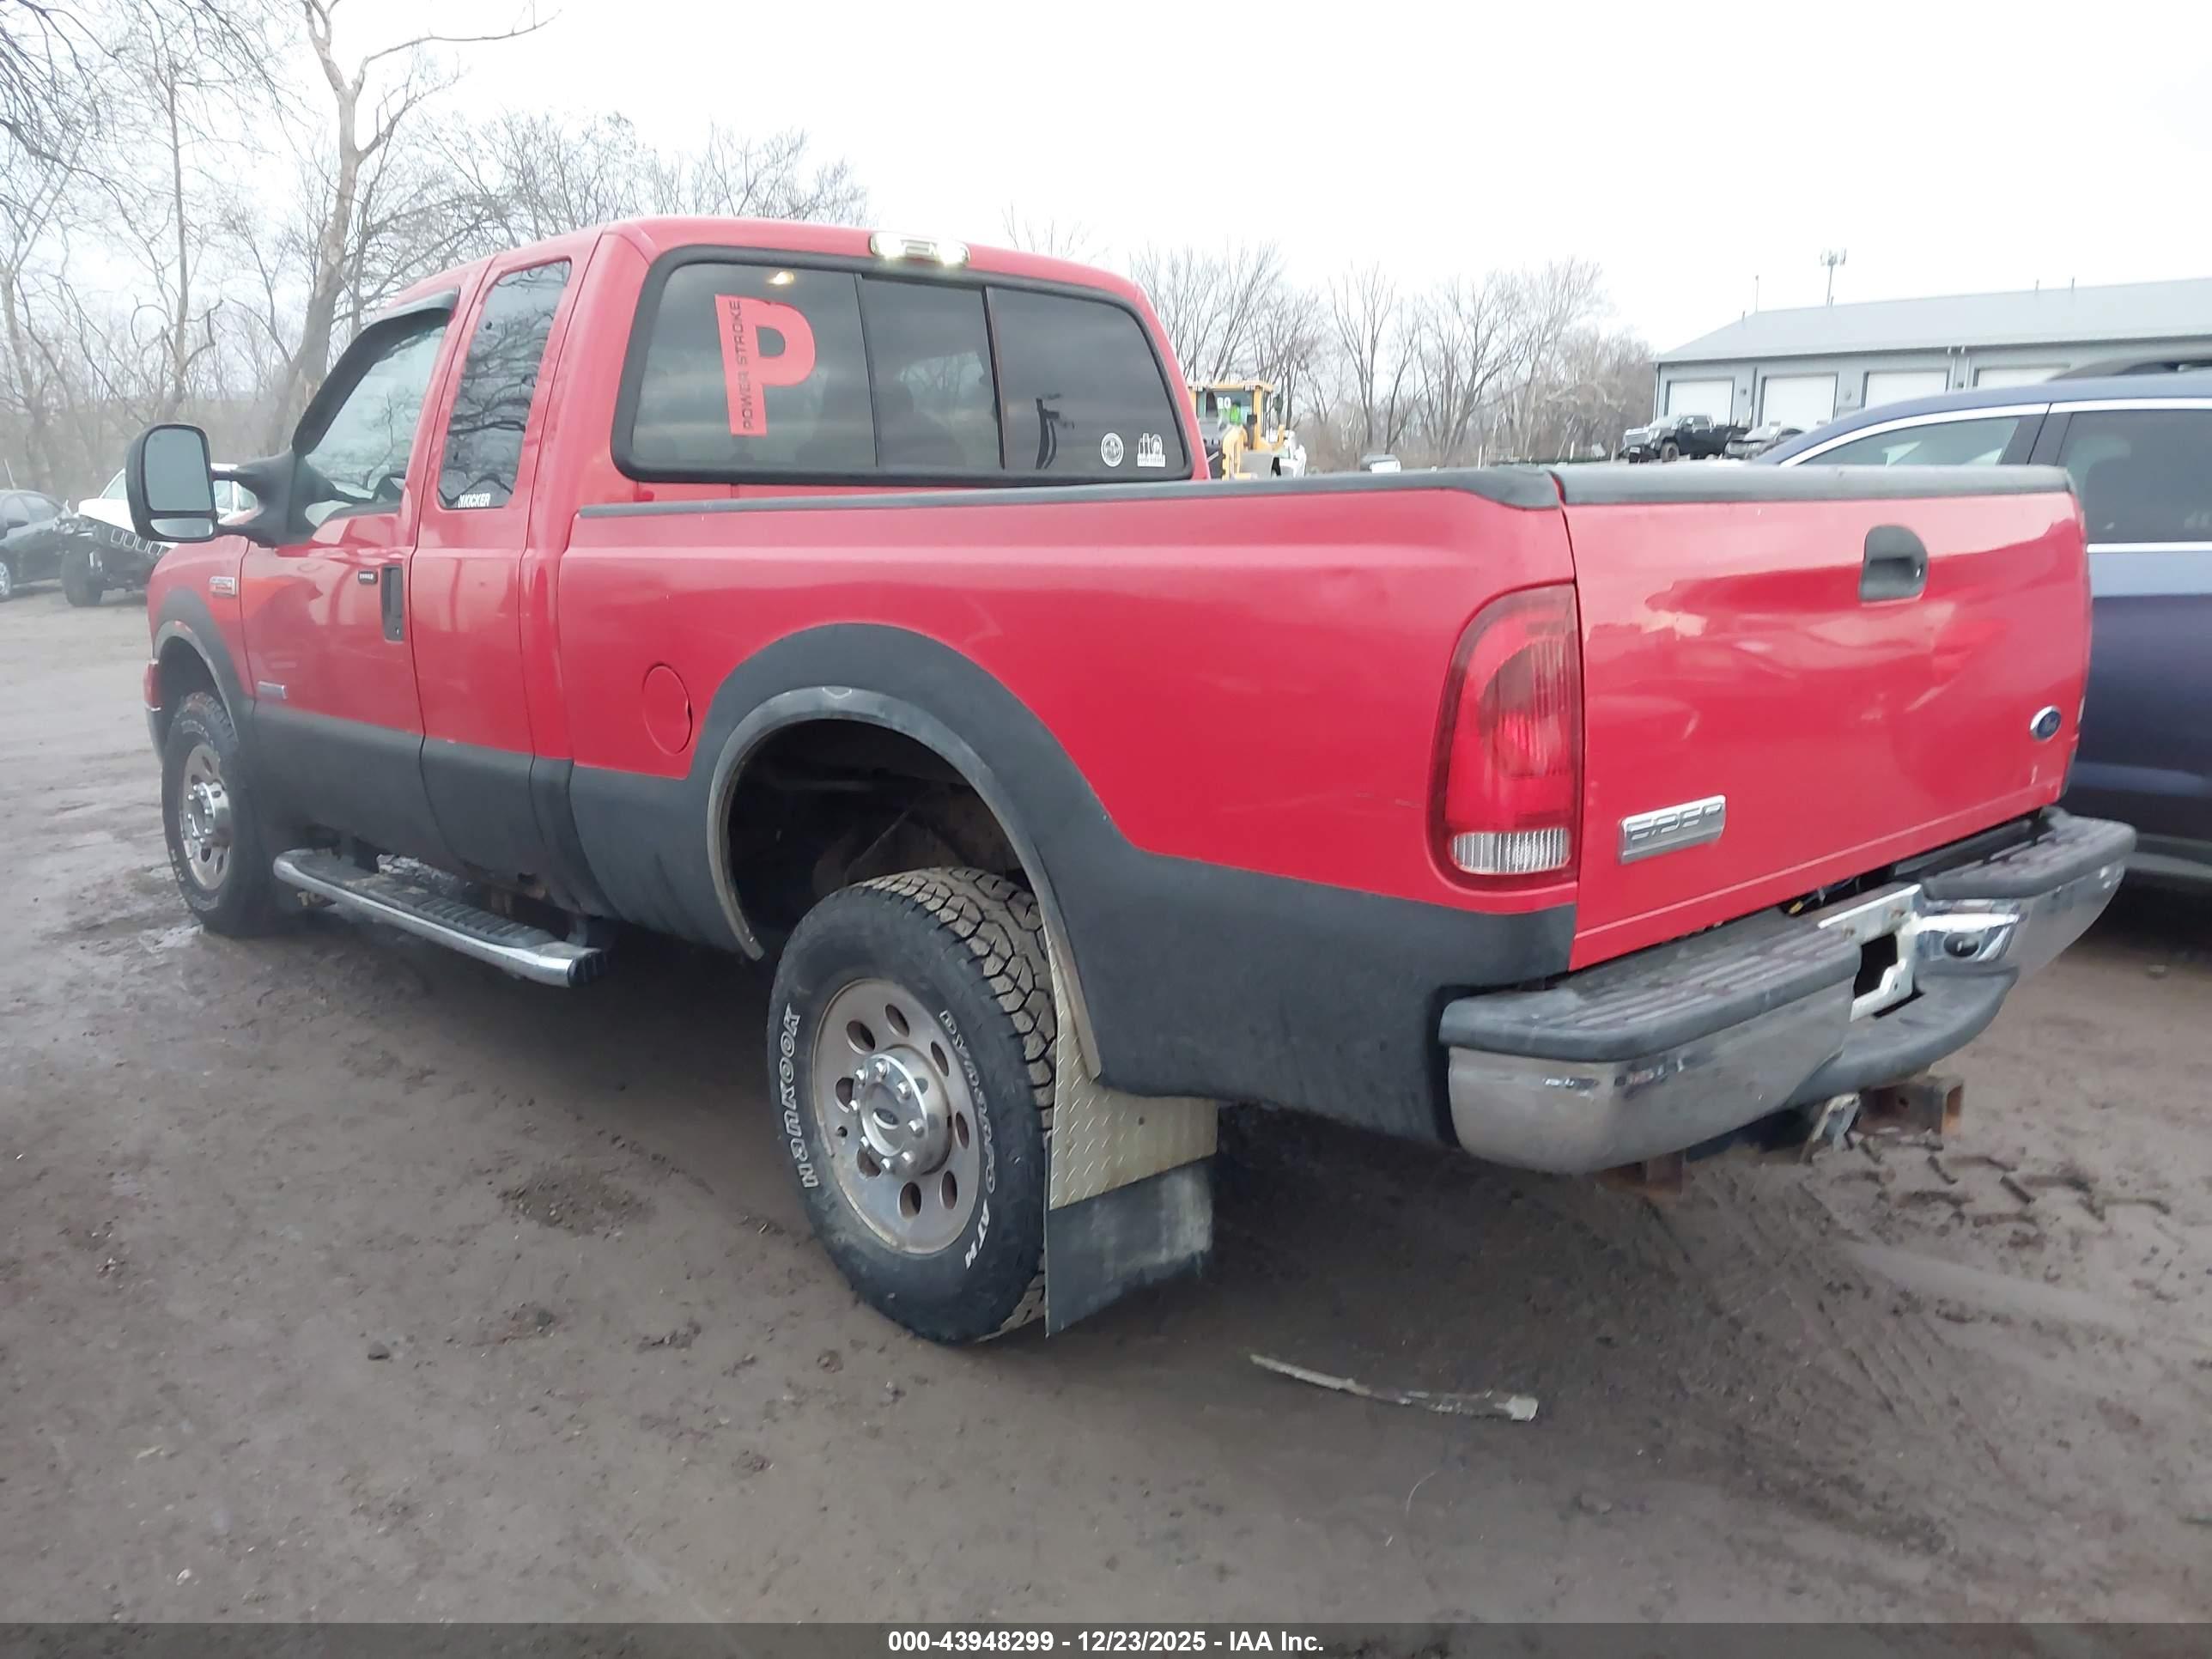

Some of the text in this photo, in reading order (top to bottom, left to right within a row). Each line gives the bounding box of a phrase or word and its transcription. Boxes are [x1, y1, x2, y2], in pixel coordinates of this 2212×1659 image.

[729, 300, 754, 430] POWER STROKE
[779, 1002, 819, 1188] HANKOOK
[939, 1009, 996, 1194] DYNAPRO
